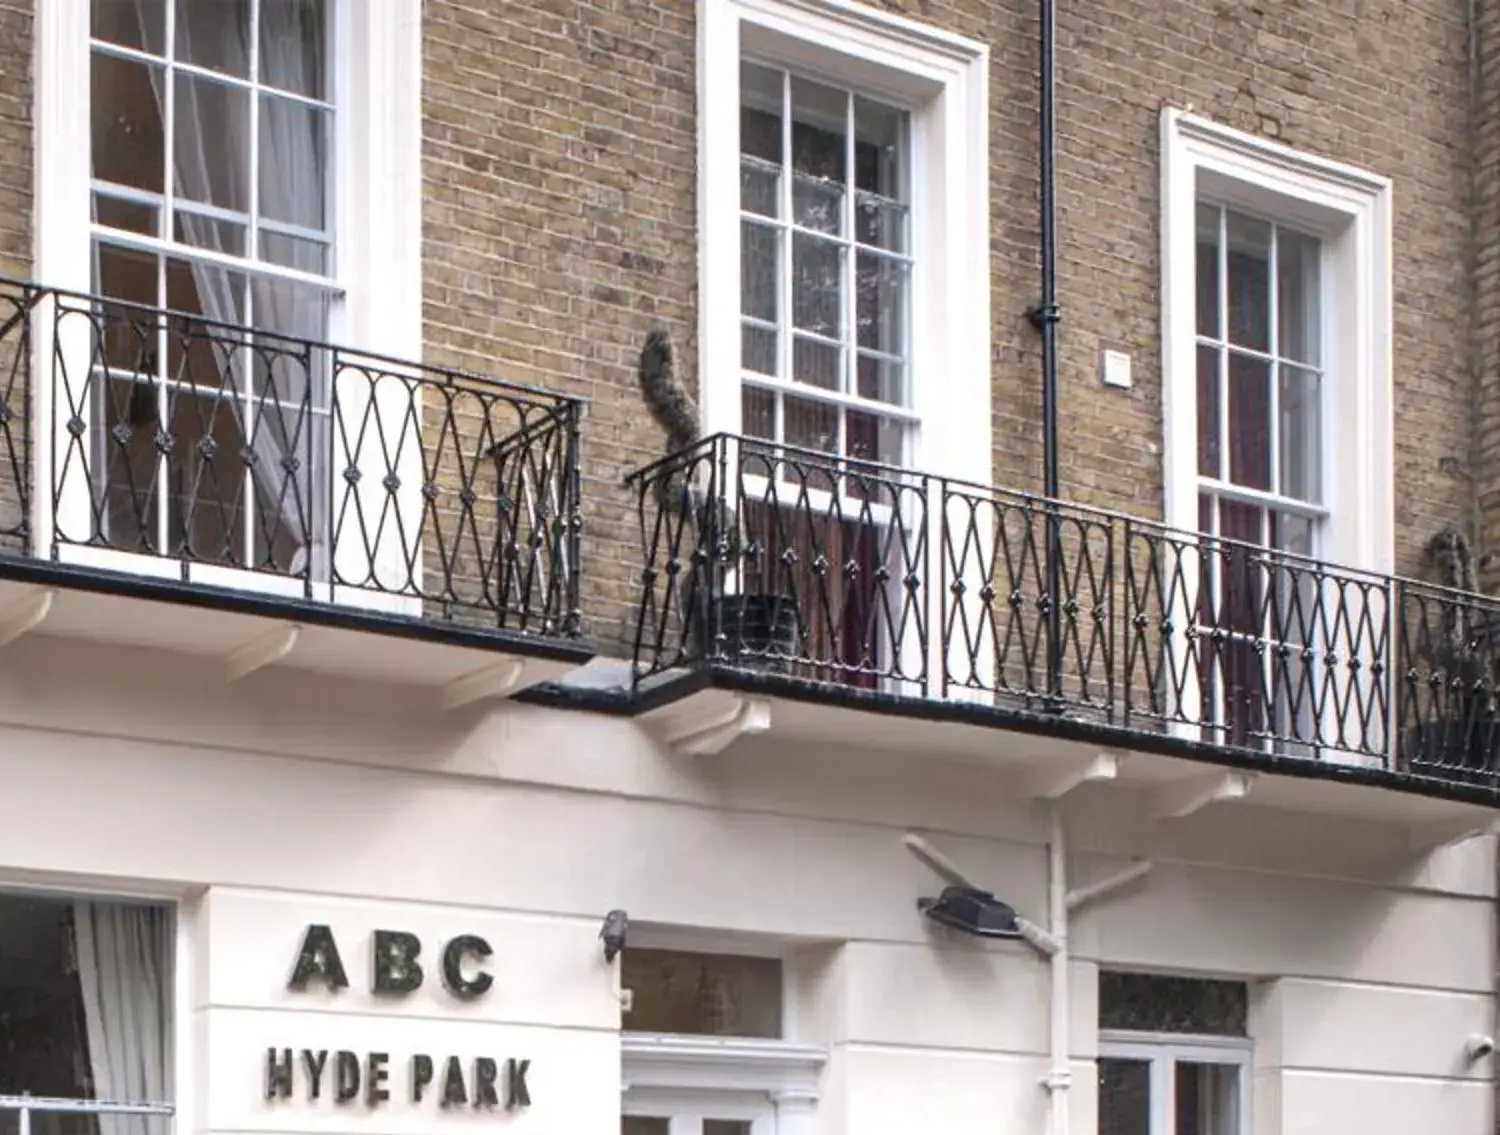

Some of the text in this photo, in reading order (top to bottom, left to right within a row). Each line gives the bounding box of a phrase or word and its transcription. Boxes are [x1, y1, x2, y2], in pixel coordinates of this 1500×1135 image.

[286, 923, 495, 1001] ABC
[264, 1046, 532, 1112] HYDE PARK
